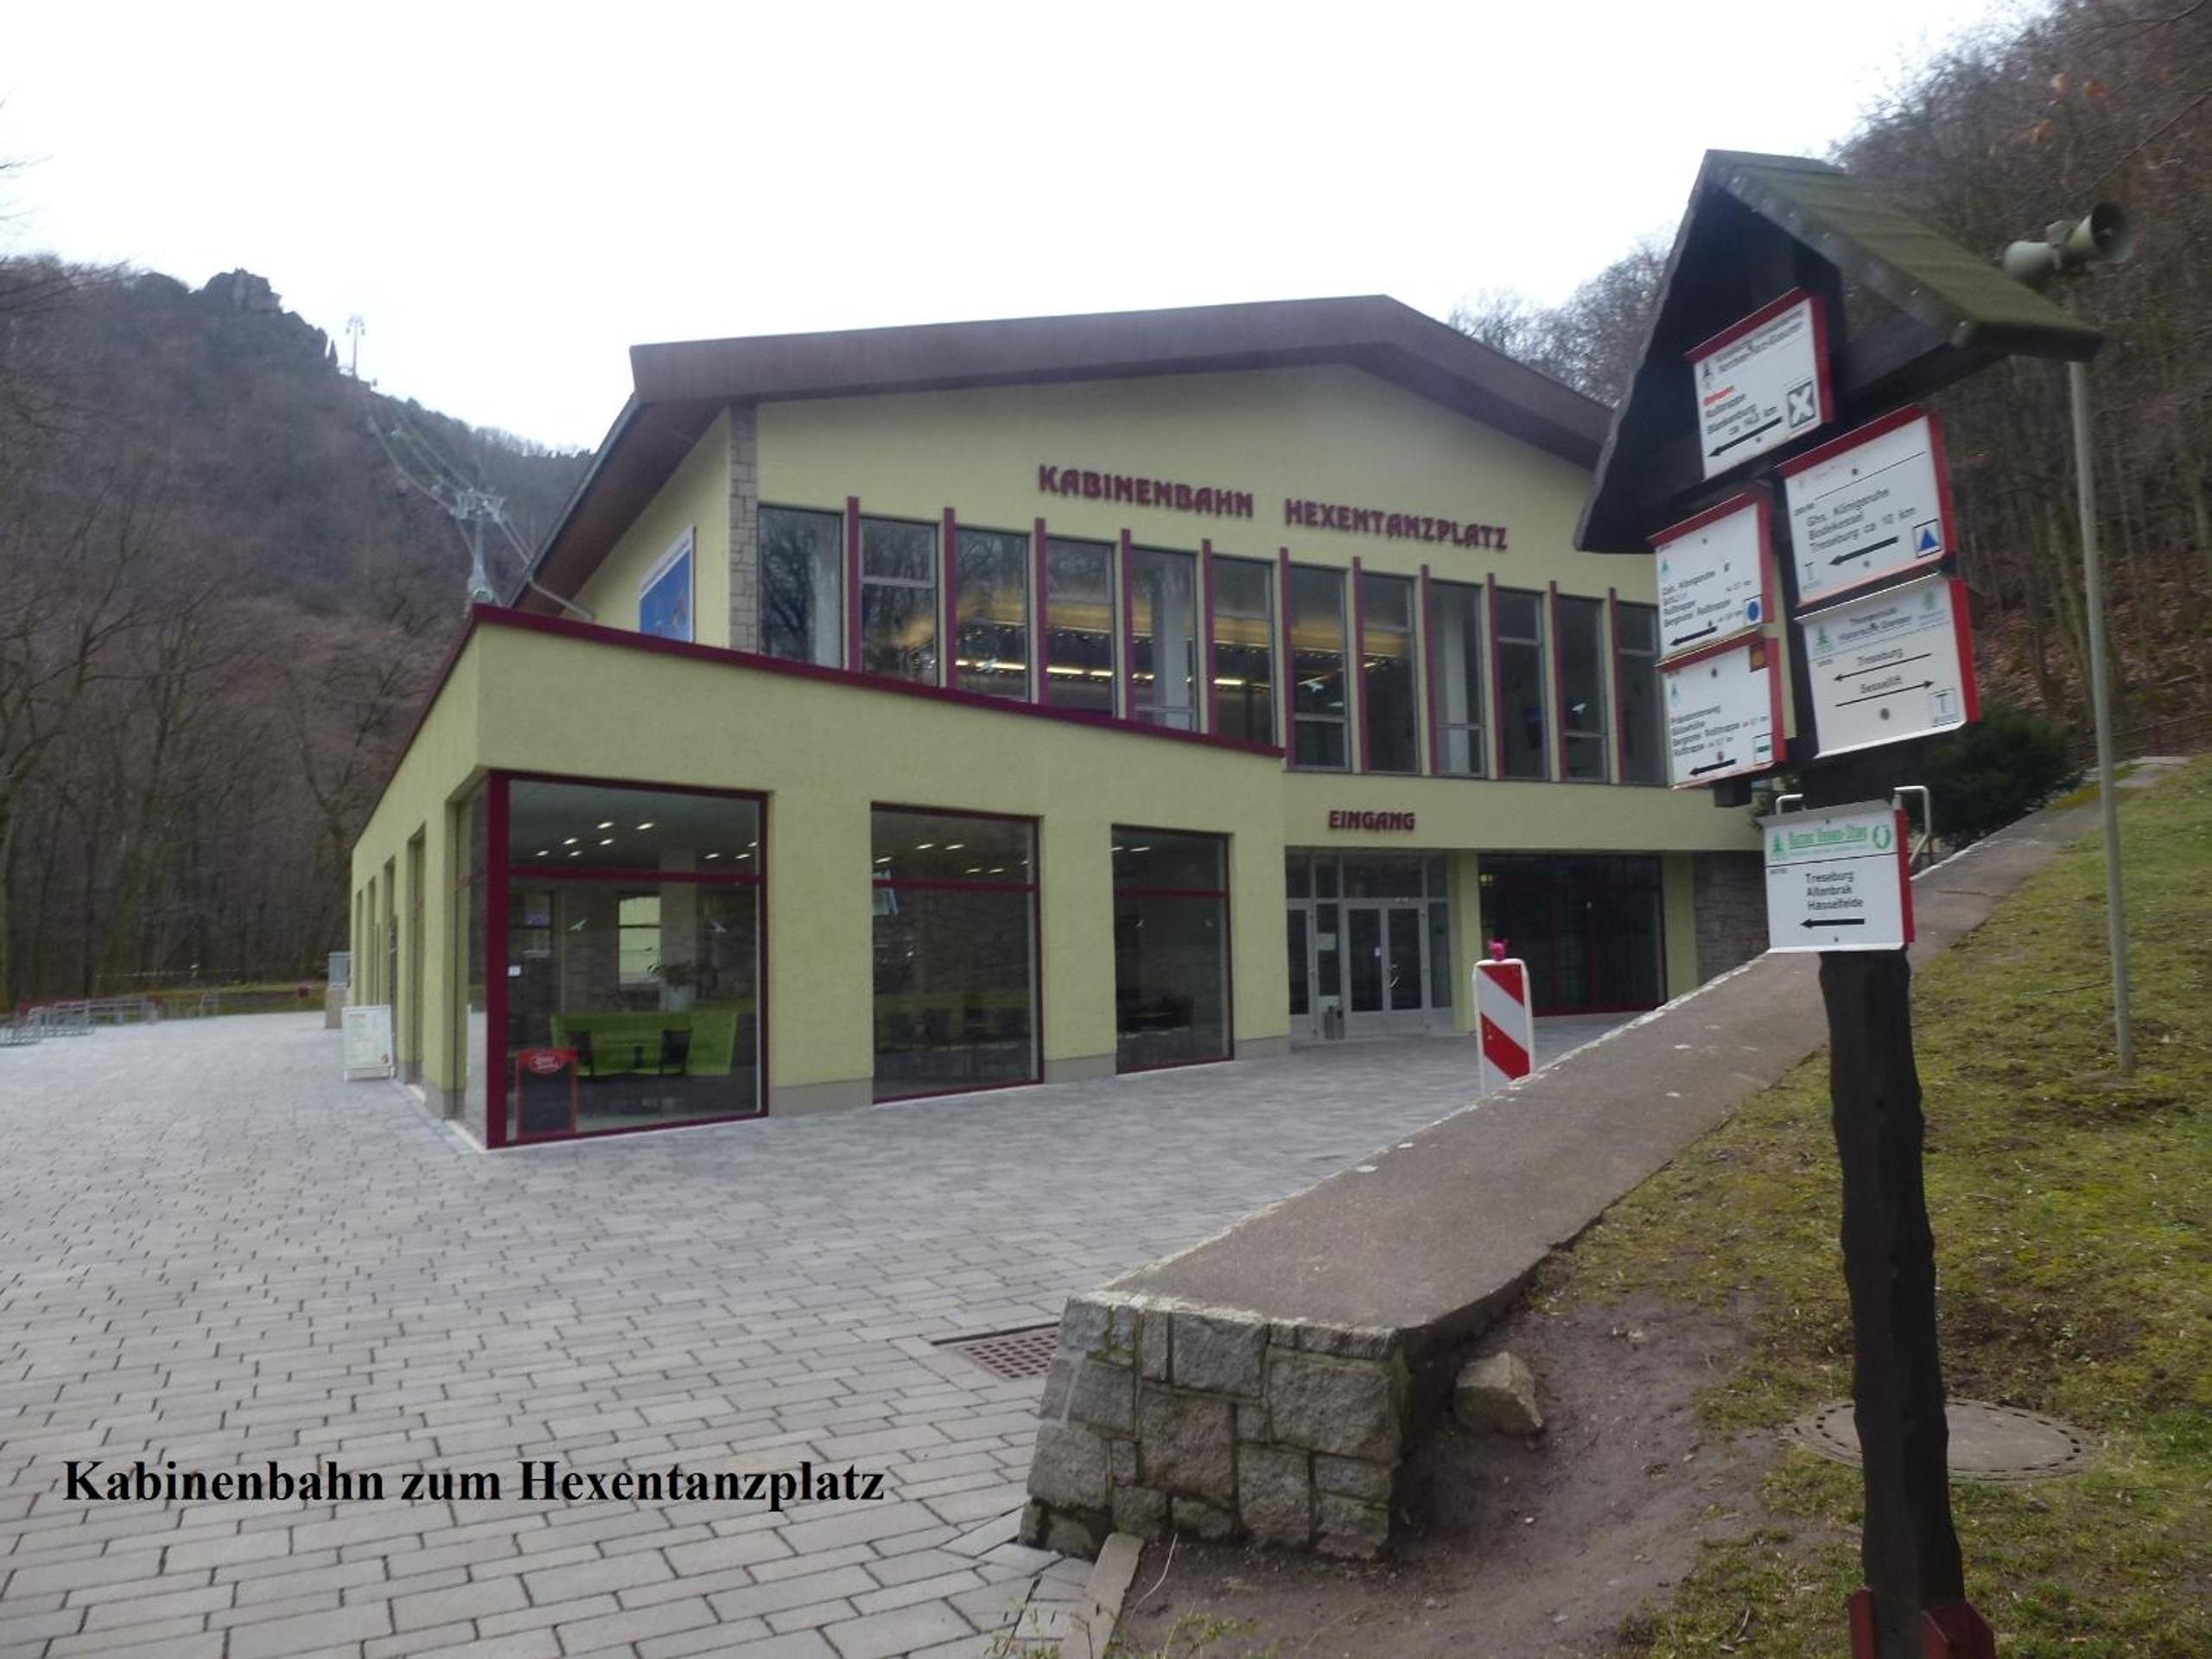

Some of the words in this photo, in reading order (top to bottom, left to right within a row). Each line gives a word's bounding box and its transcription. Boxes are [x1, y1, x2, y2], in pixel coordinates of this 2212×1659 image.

[1039, 464, 1253, 518] KABINENBAHN
[1285, 498, 1508, 551] HEXENTANZPLATZ
[1329, 810, 1415, 831] EINGANG
[1805, 871, 1854, 884] Treseburg
[1808, 898, 1864, 911] Hasselfelde
